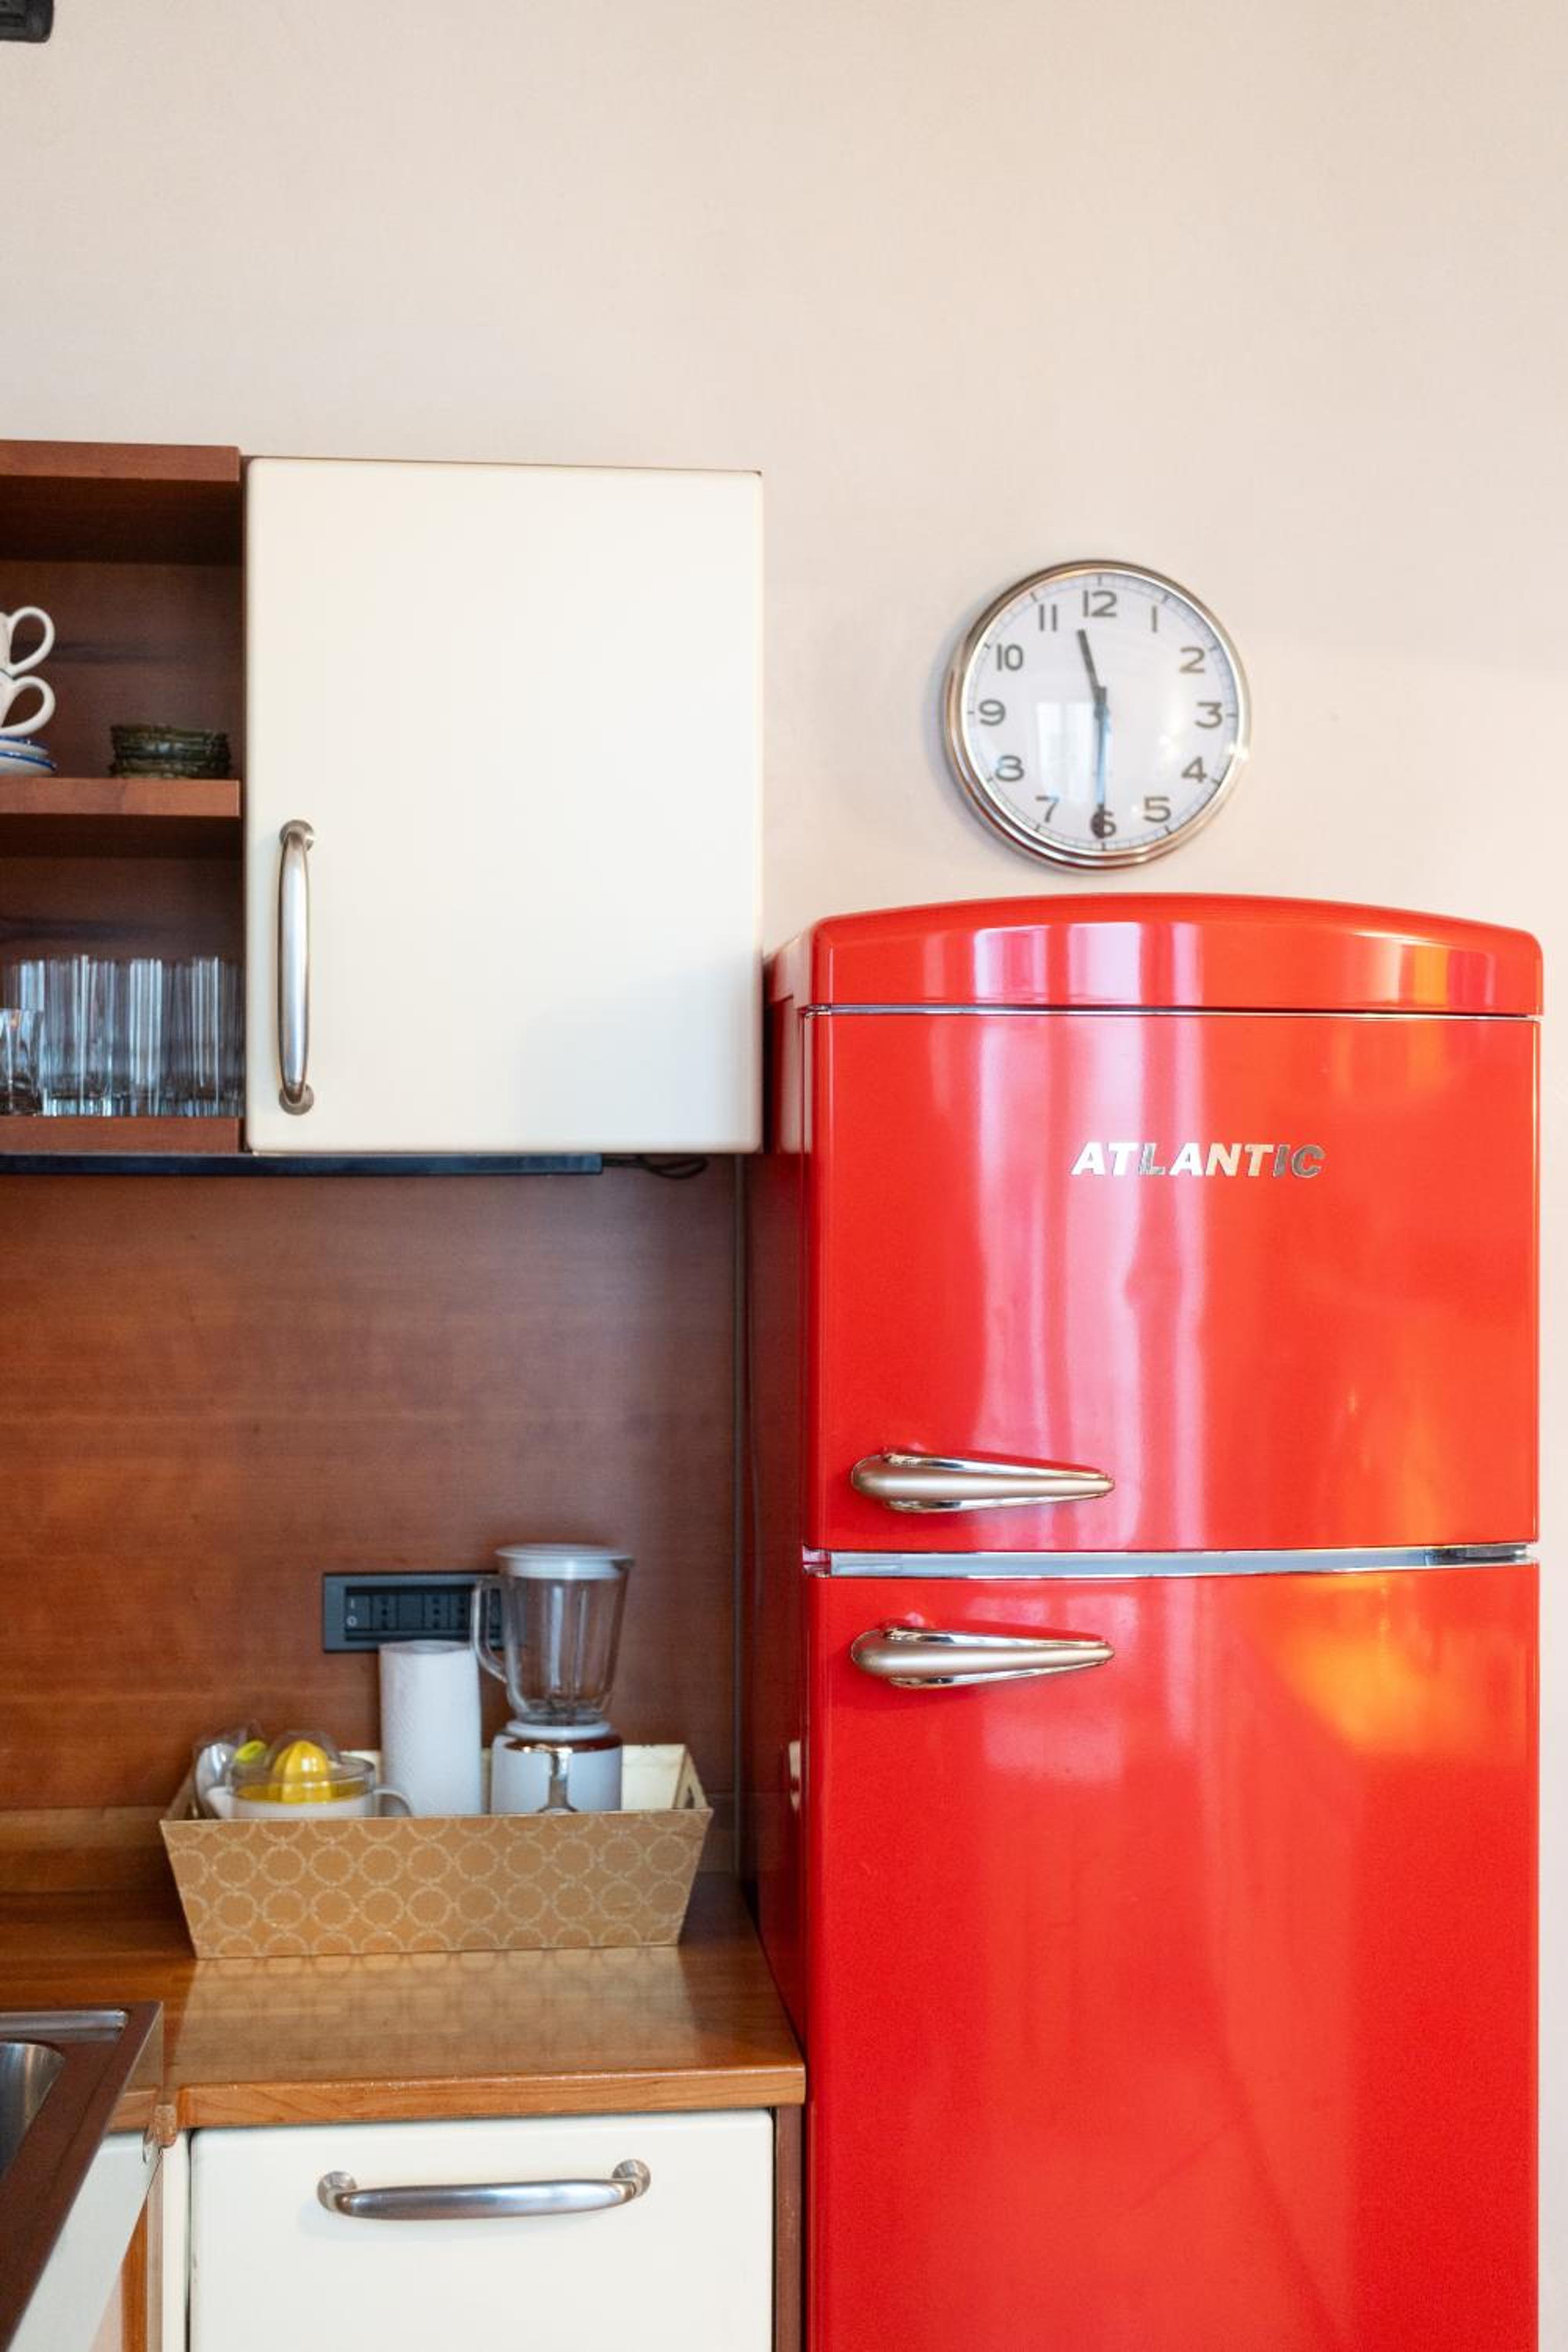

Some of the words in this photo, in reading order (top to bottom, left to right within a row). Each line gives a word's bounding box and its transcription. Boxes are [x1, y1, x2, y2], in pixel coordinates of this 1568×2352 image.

[1039, 604, 1058, 632] 11
[1082, 590, 1117, 618] 12
[1151, 604, 1158, 633] 1
[996, 644, 1023, 671] 10
[1179, 646, 1206, 673] 2
[978, 699, 1006, 727] 9
[1195, 702, 1223, 729] 3
[995, 754, 1025, 782] 8
[1181, 757, 1207, 783] 4
[1036, 795, 1059, 823] 7
[1142, 797, 1171, 823] 5
[1090, 810, 1117, 839] 6
[1071, 1142, 1326, 1178] ATLANTIC
